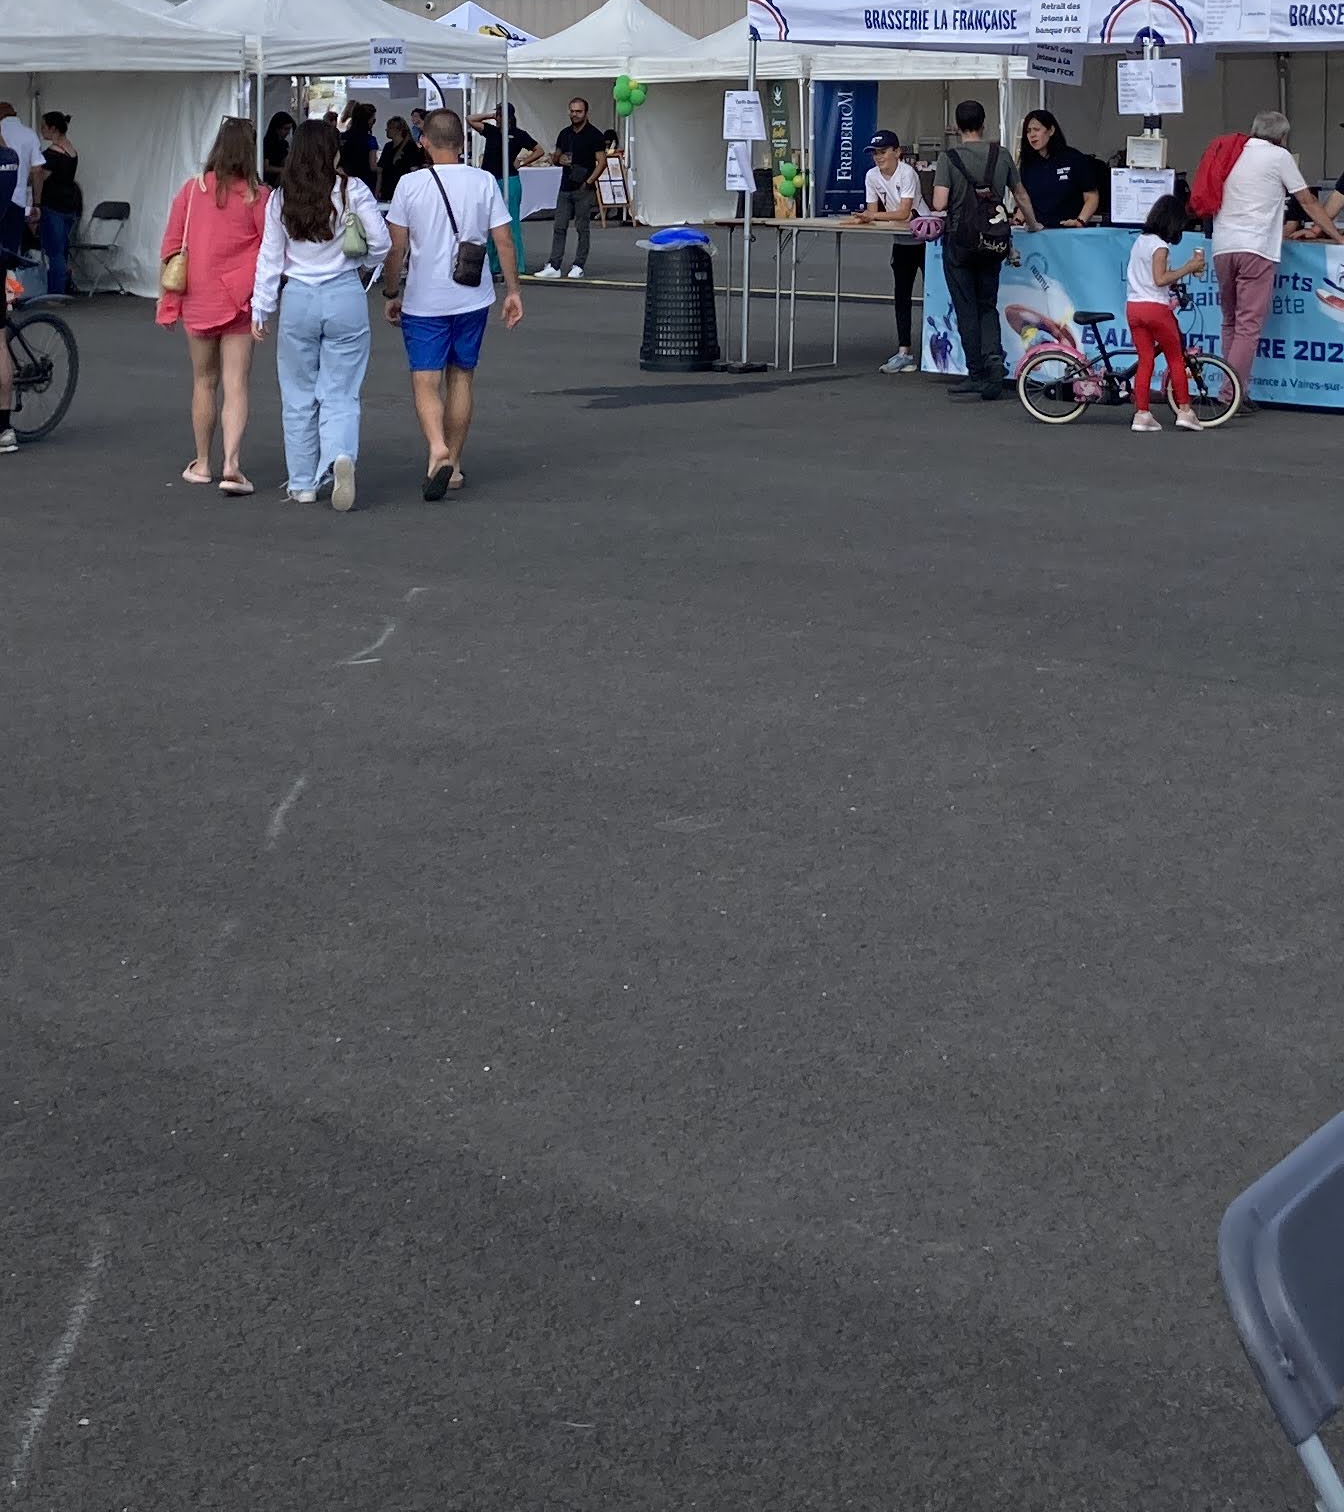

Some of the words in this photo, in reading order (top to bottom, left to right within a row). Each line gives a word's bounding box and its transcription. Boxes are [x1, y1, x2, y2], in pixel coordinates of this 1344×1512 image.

[1041, 2, 1066, 10] Retrait
[1067, 2, 1081, 10] des
[864, 9, 930, 31] BRASSERIE
[934, 9, 948, 30] LA
[953, 9, 1018, 33] FRANÇAISE
[1040, 15, 1063, 23] jetons
[1064, 14, 1070, 22] à
[1035, 27, 1062, 35] banque
[373, 46, 403, 55] BANQUE
[379, 57, 397, 66] FFCK
[1063, 57, 1071, 65] la
[1281, 377, 1287, 387] à
